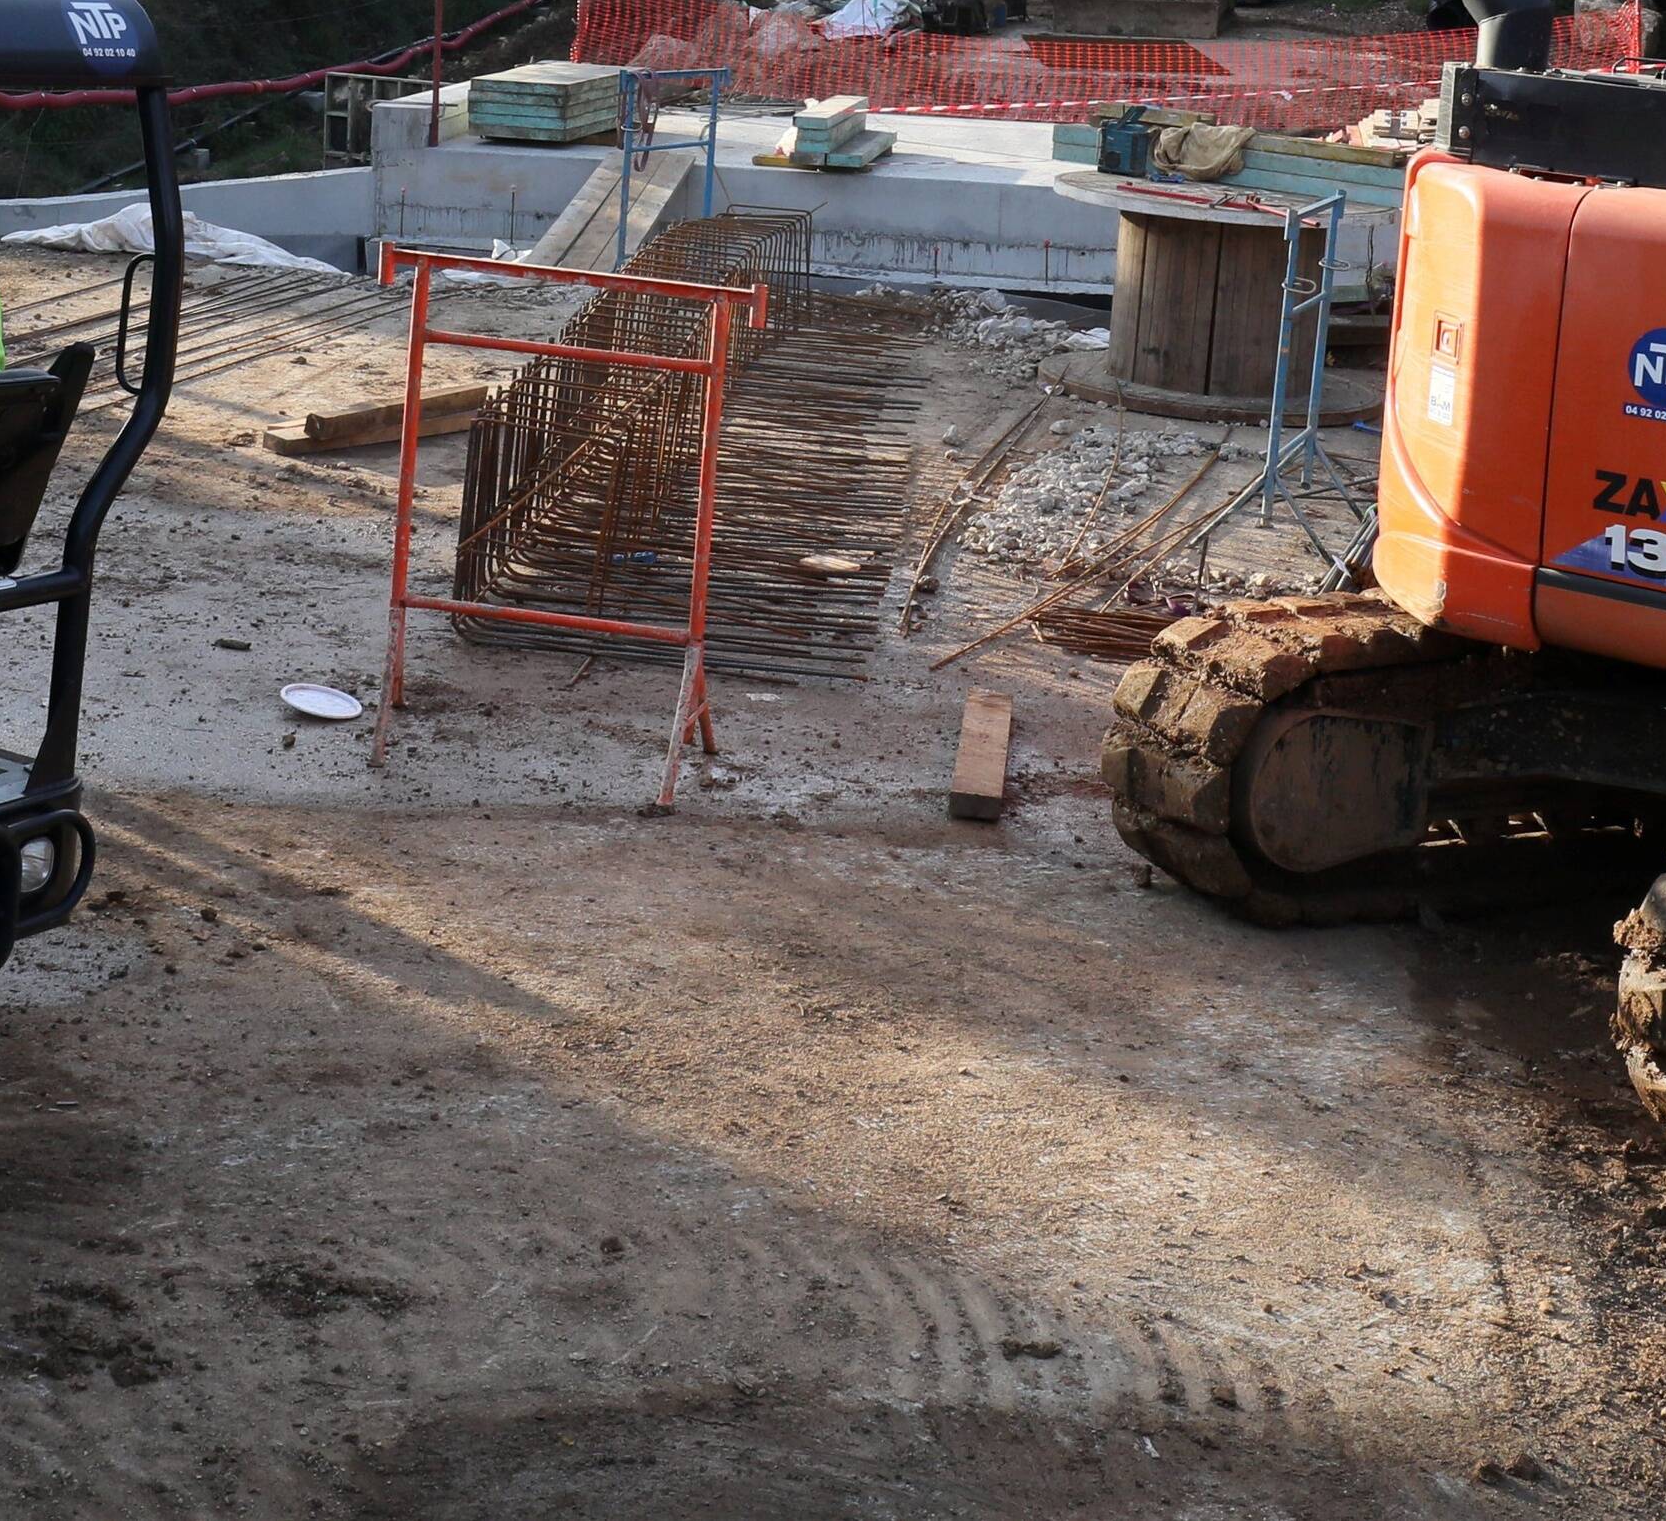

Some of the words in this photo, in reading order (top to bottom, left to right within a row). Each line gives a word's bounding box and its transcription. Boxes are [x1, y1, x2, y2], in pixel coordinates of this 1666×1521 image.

[68, 1, 127, 45] NTP
[83, 47, 93, 57] 04
[94, 47, 104, 57] 92
[105, 47, 115, 57] 02
[116, 47, 125, 57] 10
[126, 48, 135, 57] 40
[1625, 405, 1637, 416] 04
[1640, 407, 1653, 418] 92
